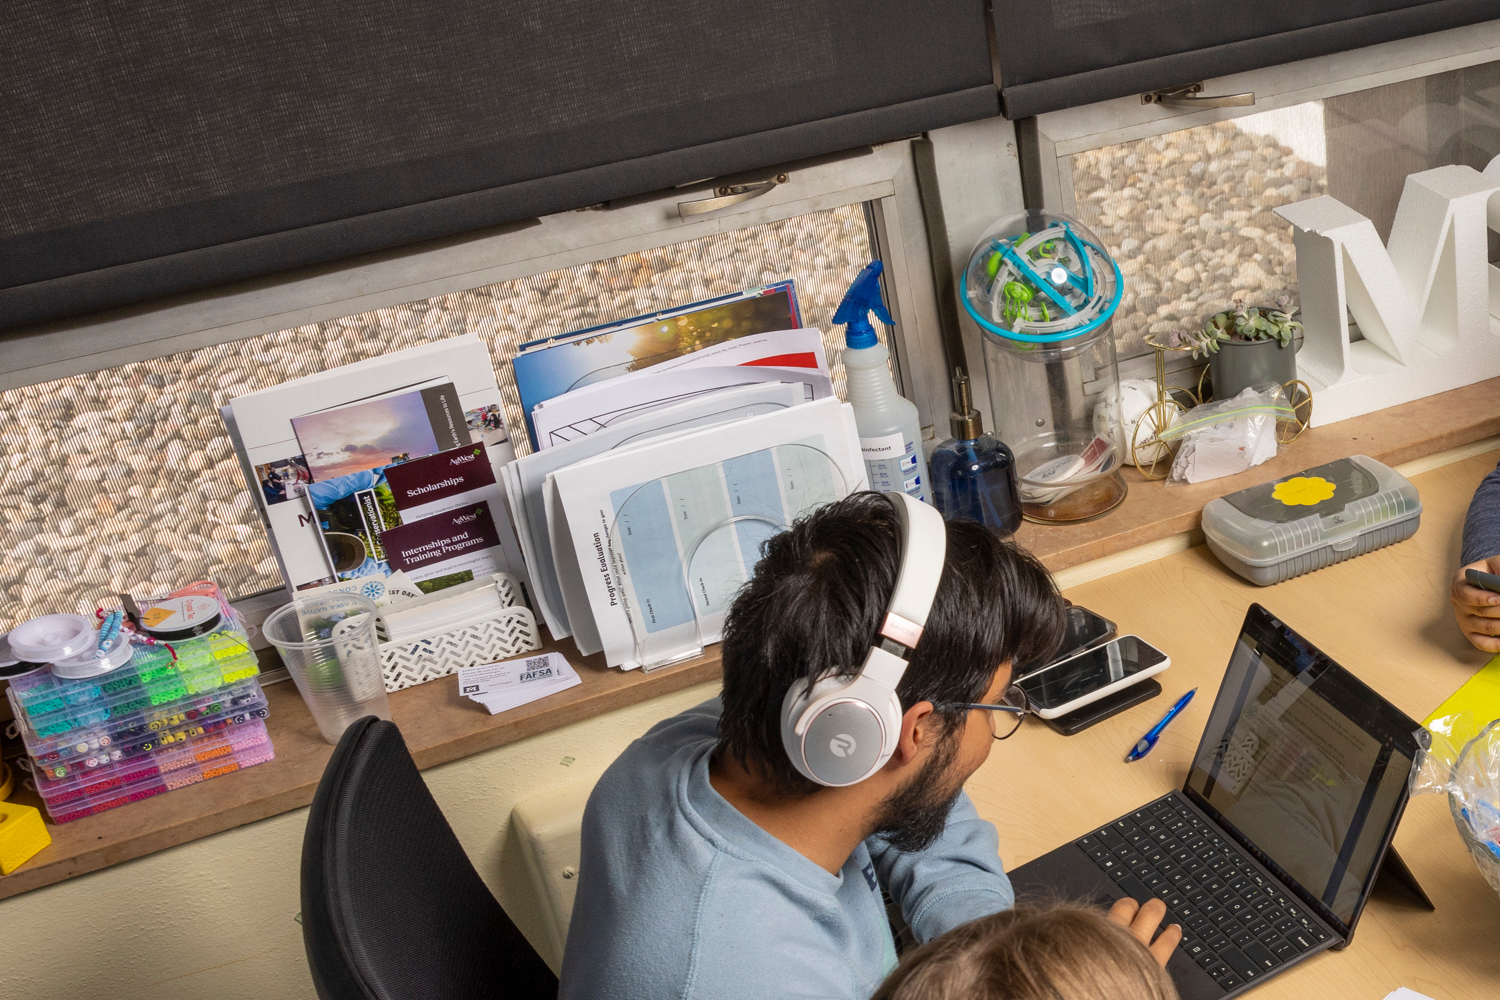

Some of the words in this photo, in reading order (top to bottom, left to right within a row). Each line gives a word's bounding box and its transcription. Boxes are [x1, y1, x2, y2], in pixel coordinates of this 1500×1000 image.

[443, 407, 454, 429] Resources
[449, 428, 458, 443] Earth's
[448, 452, 475, 466] AgWest
[406, 475, 464, 497] Scholarships
[363, 494, 383, 545] Conservationist
[451, 512, 477, 525] AgWest
[400, 536, 451, 557] Internships
[451, 531, 468, 542] and
[403, 547, 442, 565] Training
[442, 535, 484, 553] Programs
[596, 532, 609, 572] Evaluation
[603, 573, 618, 606] Progress
[184, 599, 193, 612] Crystal
[300, 605, 327, 616] NATIVE
[890, 622, 916, 639] RAYCON
[518, 668, 552, 680] FAFSA
